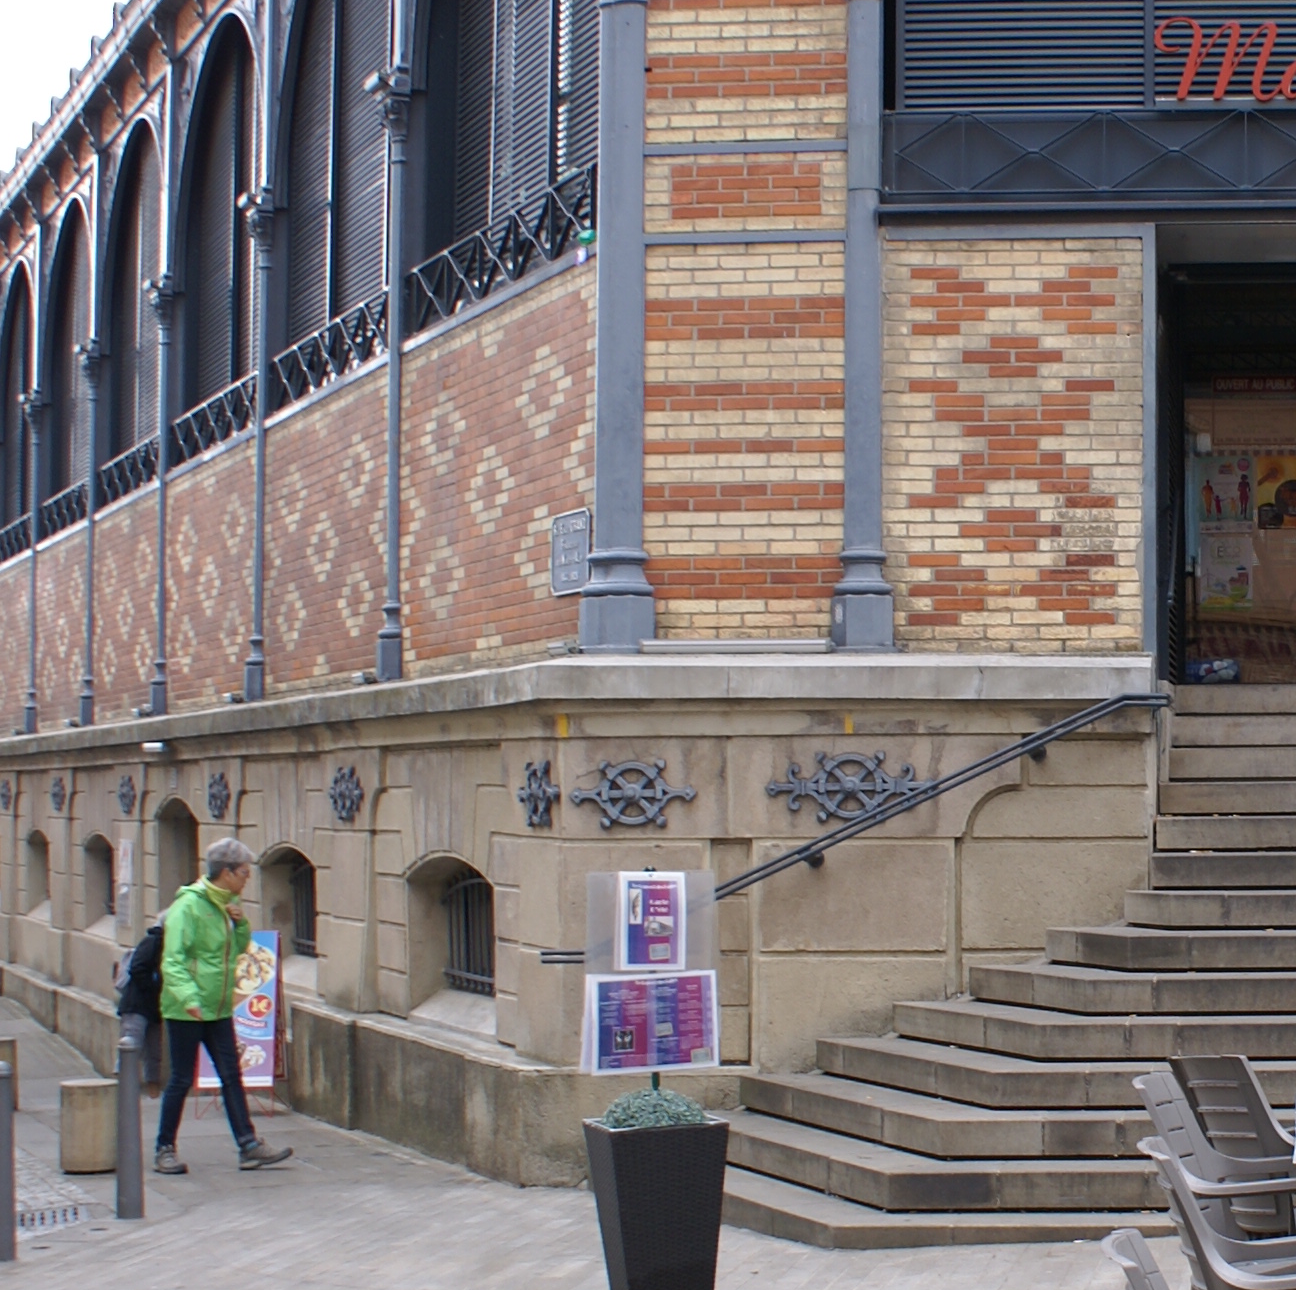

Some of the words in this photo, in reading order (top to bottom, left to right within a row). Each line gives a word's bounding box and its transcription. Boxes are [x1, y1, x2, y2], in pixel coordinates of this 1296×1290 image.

[1216, 378, 1249, 391] OUVERT
[1251, 378, 1264, 391] AU
[1266, 378, 1296, 391] PUBLIC
